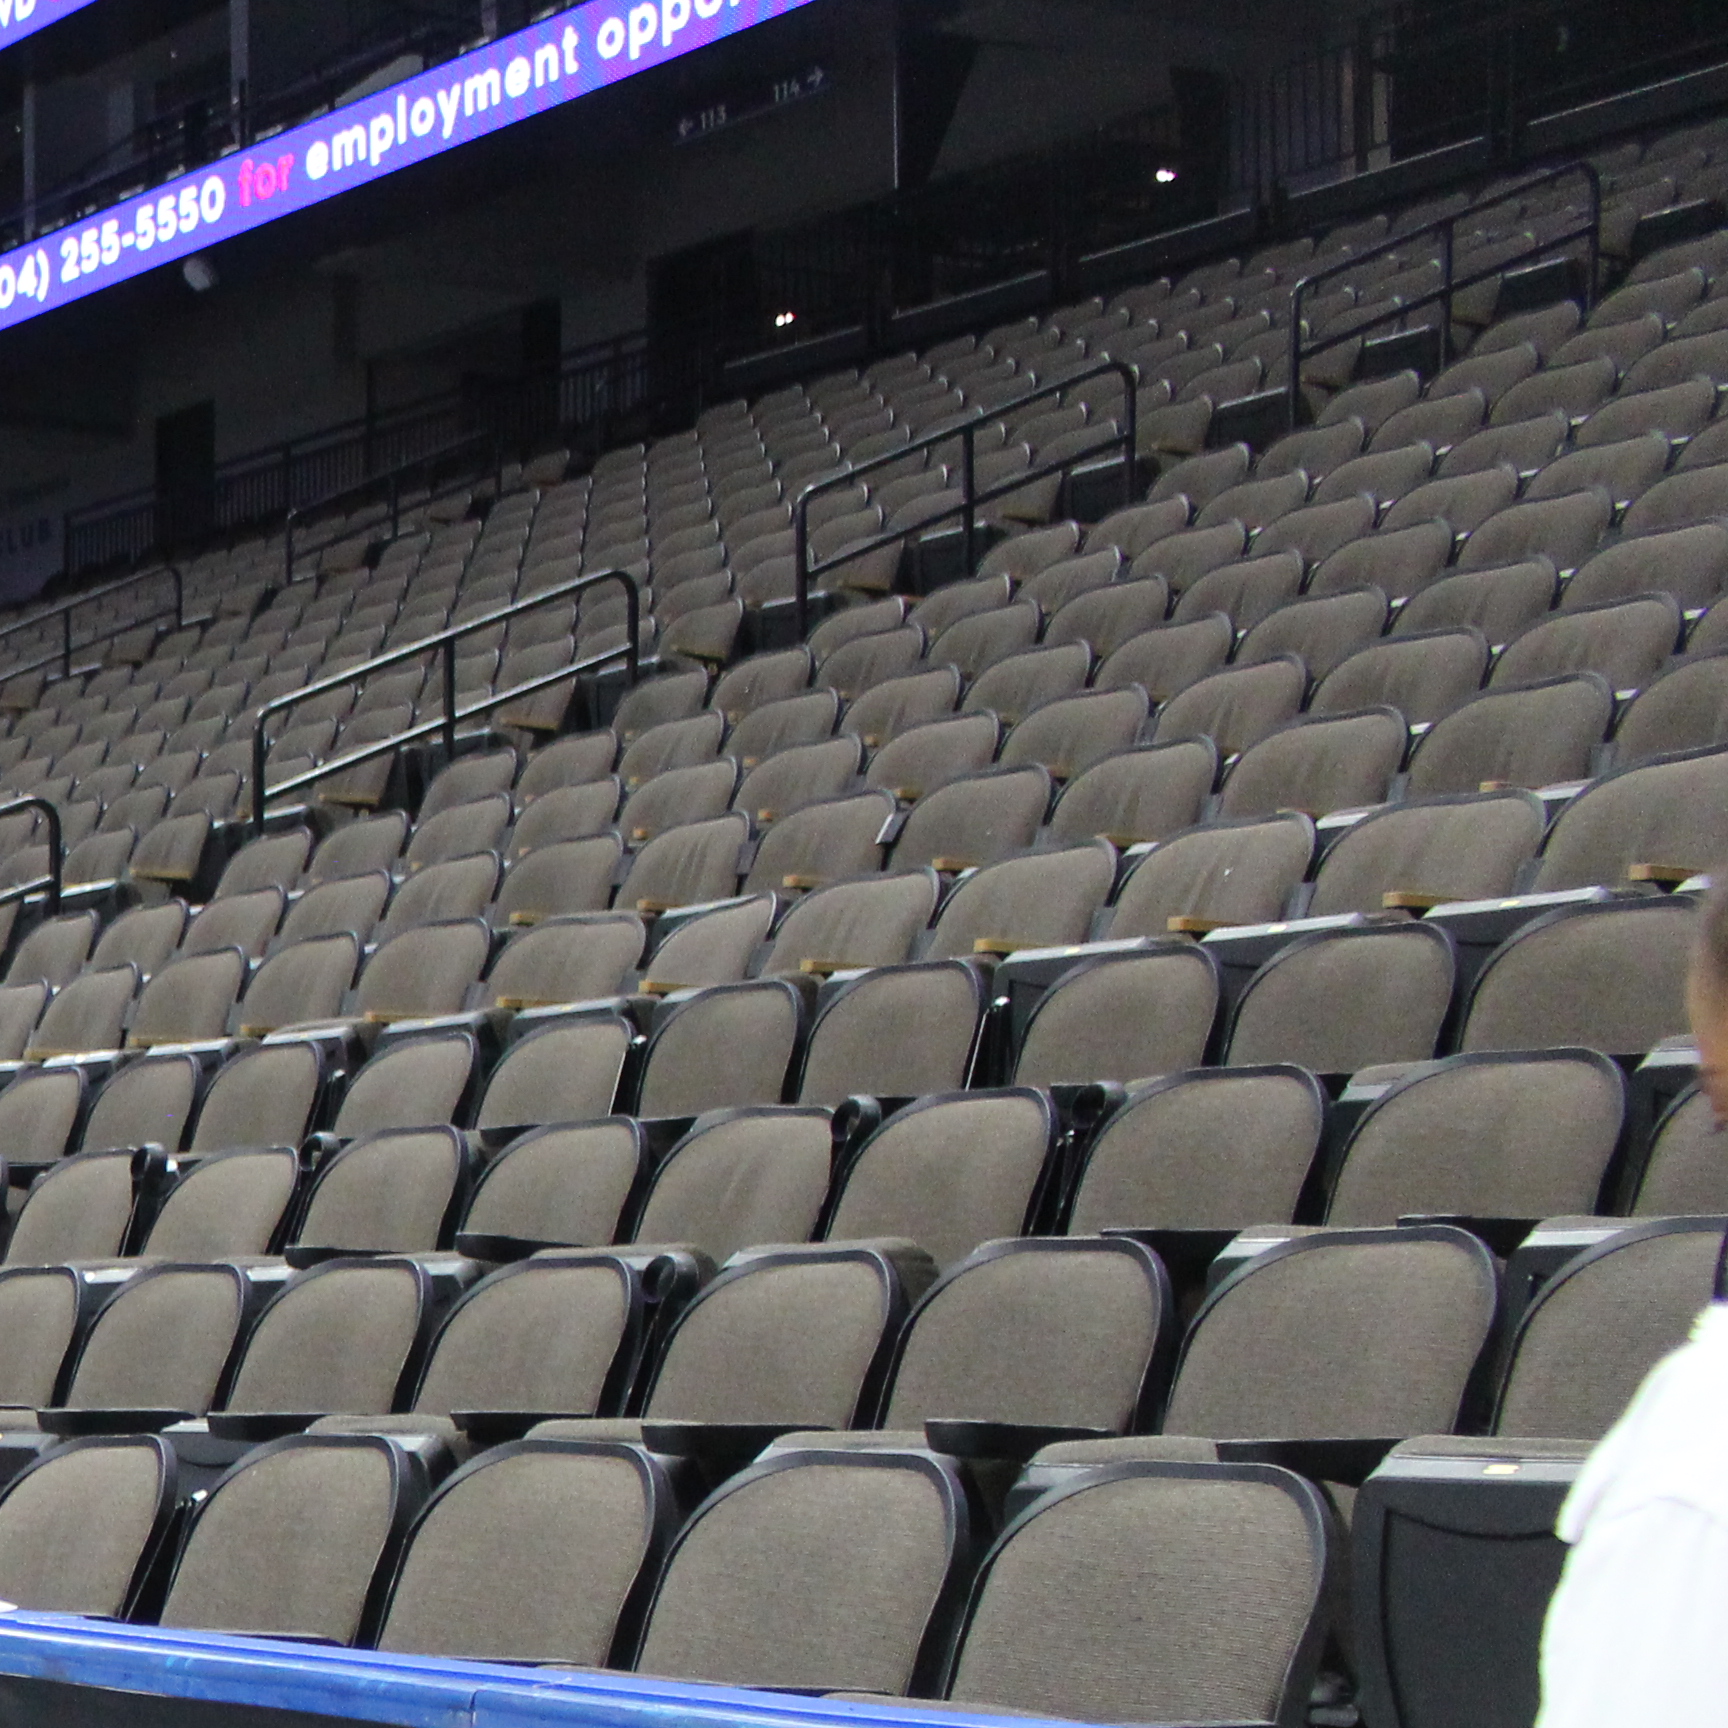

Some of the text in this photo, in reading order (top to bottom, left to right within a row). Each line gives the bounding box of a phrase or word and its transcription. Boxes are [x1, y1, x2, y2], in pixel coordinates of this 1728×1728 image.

[60, 175, 227, 284] 255-5550
[236, 153, 296, 208] for
[305, 24, 580, 181] employment
[596, 0, 740, 61] oppo
